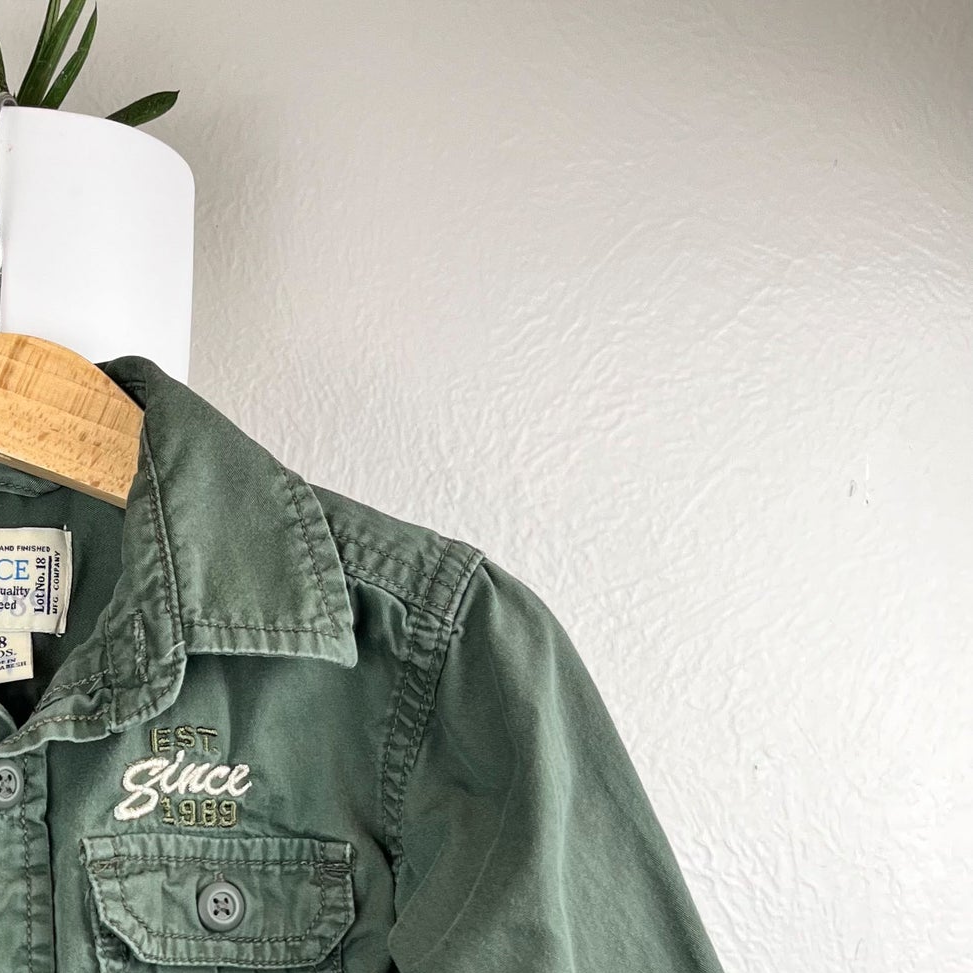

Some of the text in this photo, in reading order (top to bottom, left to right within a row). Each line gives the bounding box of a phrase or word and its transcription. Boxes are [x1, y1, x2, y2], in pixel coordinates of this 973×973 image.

[34, 557, 46, 613] Lot No. 18
[53, 550, 61, 591] COMPANY
[113, 750, 252, 821] Since
